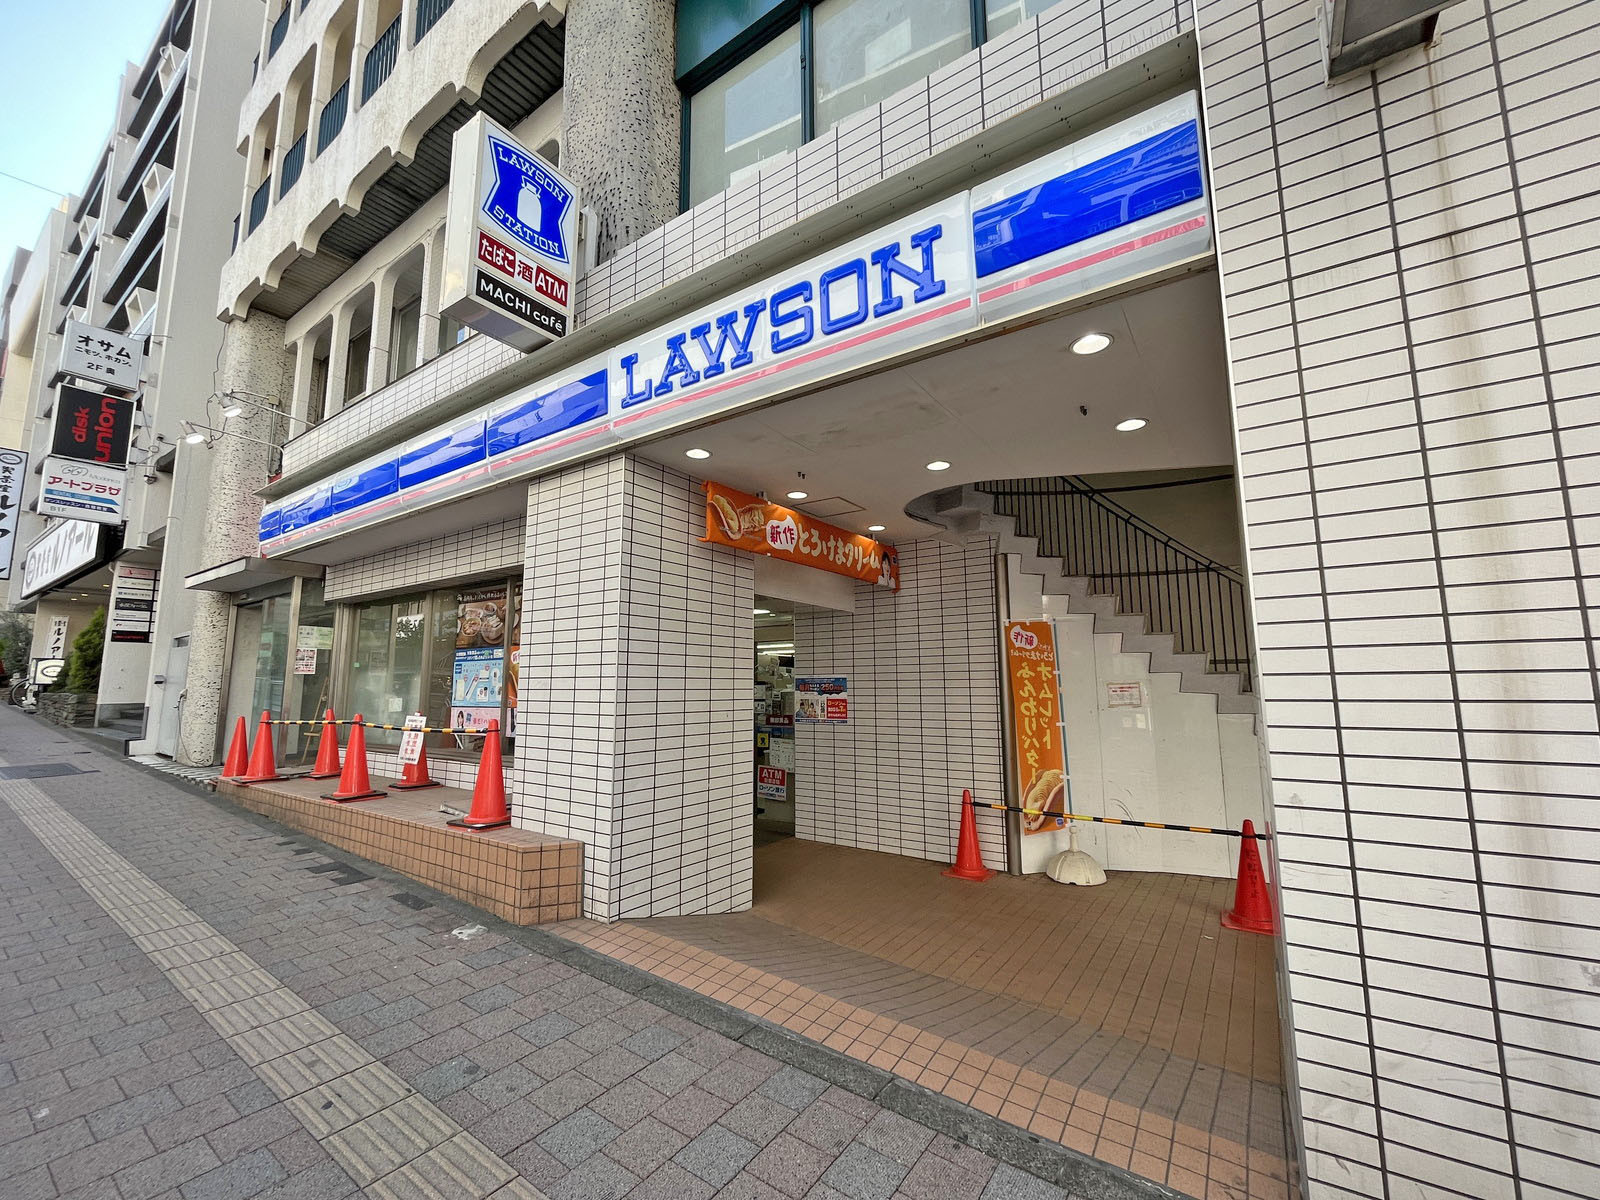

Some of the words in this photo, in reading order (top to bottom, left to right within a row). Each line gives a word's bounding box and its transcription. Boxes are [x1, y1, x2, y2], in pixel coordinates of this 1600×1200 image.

[497, 146, 566, 203] LAWSON
[493, 205, 561, 255] STATION
[480, 238, 516, 273] たばこ
[517, 260, 533, 283] 酒
[536, 268, 566, 302] ATM
[480, 279, 531, 315] MACHI
[533, 309, 563, 332] café
[620, 223, 946, 409] LAWSON
[77, 334, 132, 360] オサム
[86, 362, 103, 371] 2F
[72, 406, 91, 443] disk
[94, 397, 118, 463] union
[50, 505, 67, 513] B1F
[769, 524, 796, 545] 新作
[51, 627, 65, 659] ルノア
[761, 768, 783, 780] ATM
